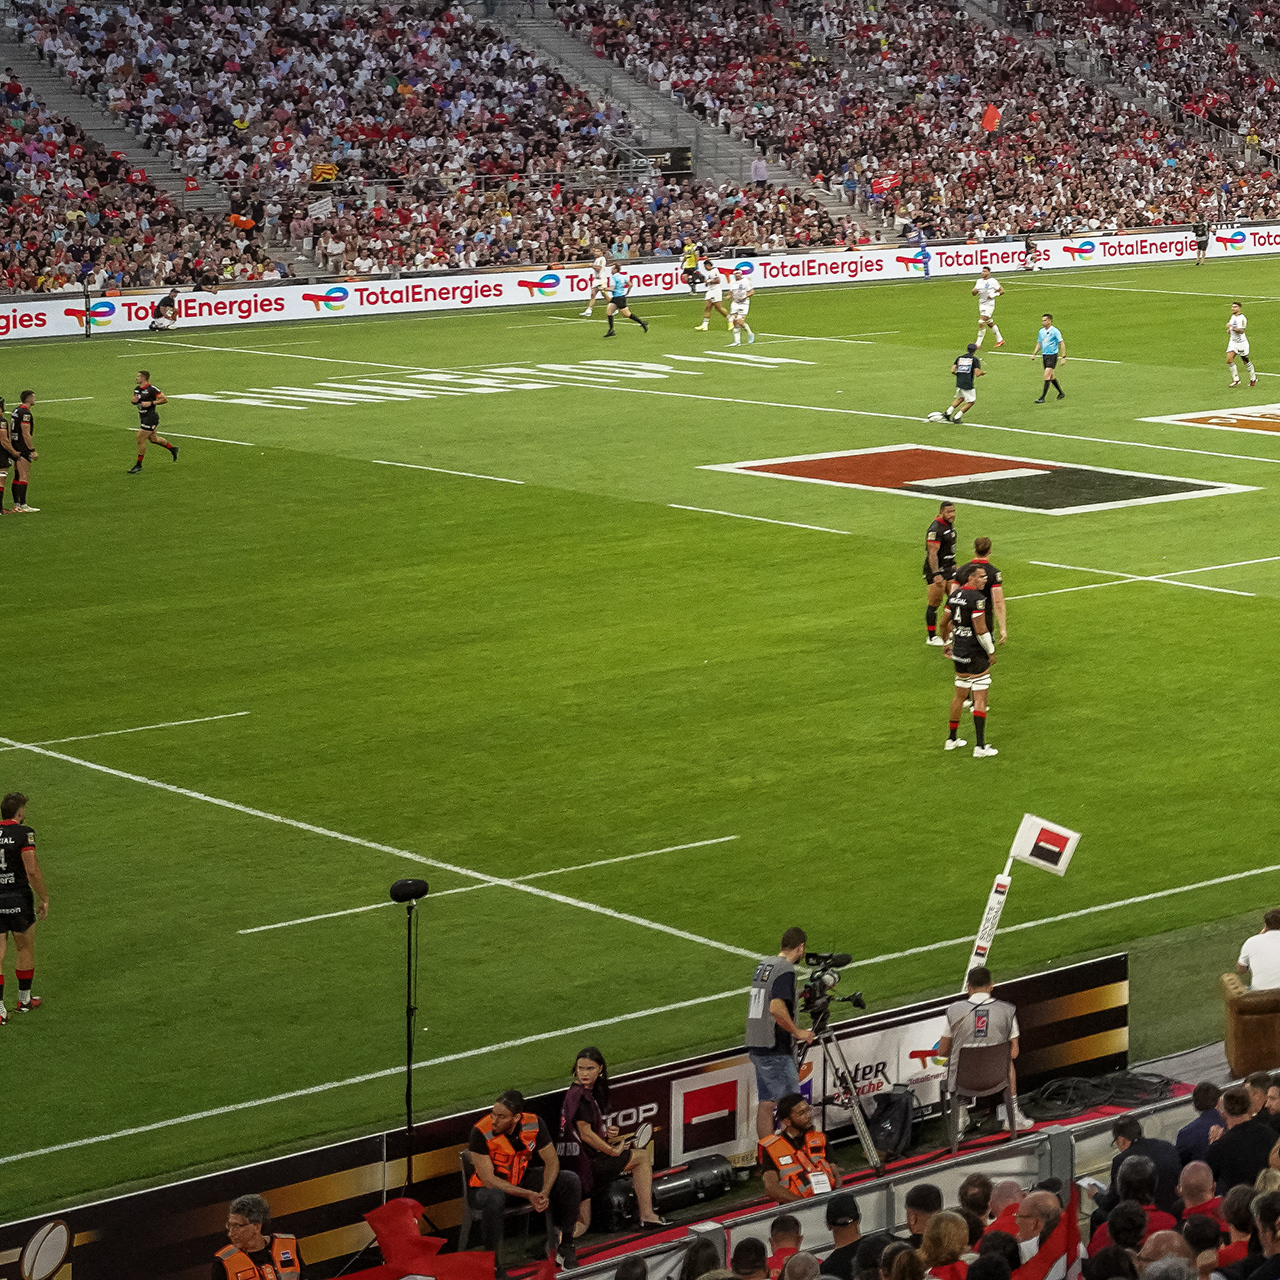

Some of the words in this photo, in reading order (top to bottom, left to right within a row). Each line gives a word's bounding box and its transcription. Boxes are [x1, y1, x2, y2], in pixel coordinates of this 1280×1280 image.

[935, 247, 1051, 268] TotalEnerges
[1099, 236, 1198, 258] TotalEnergie
[759, 256, 884, 280] TotalEnergies
[354, 280, 503, 306] TotalEnergies
[122, 293, 285, 322] TotlEnergies
[954, 606, 962, 624] 4
